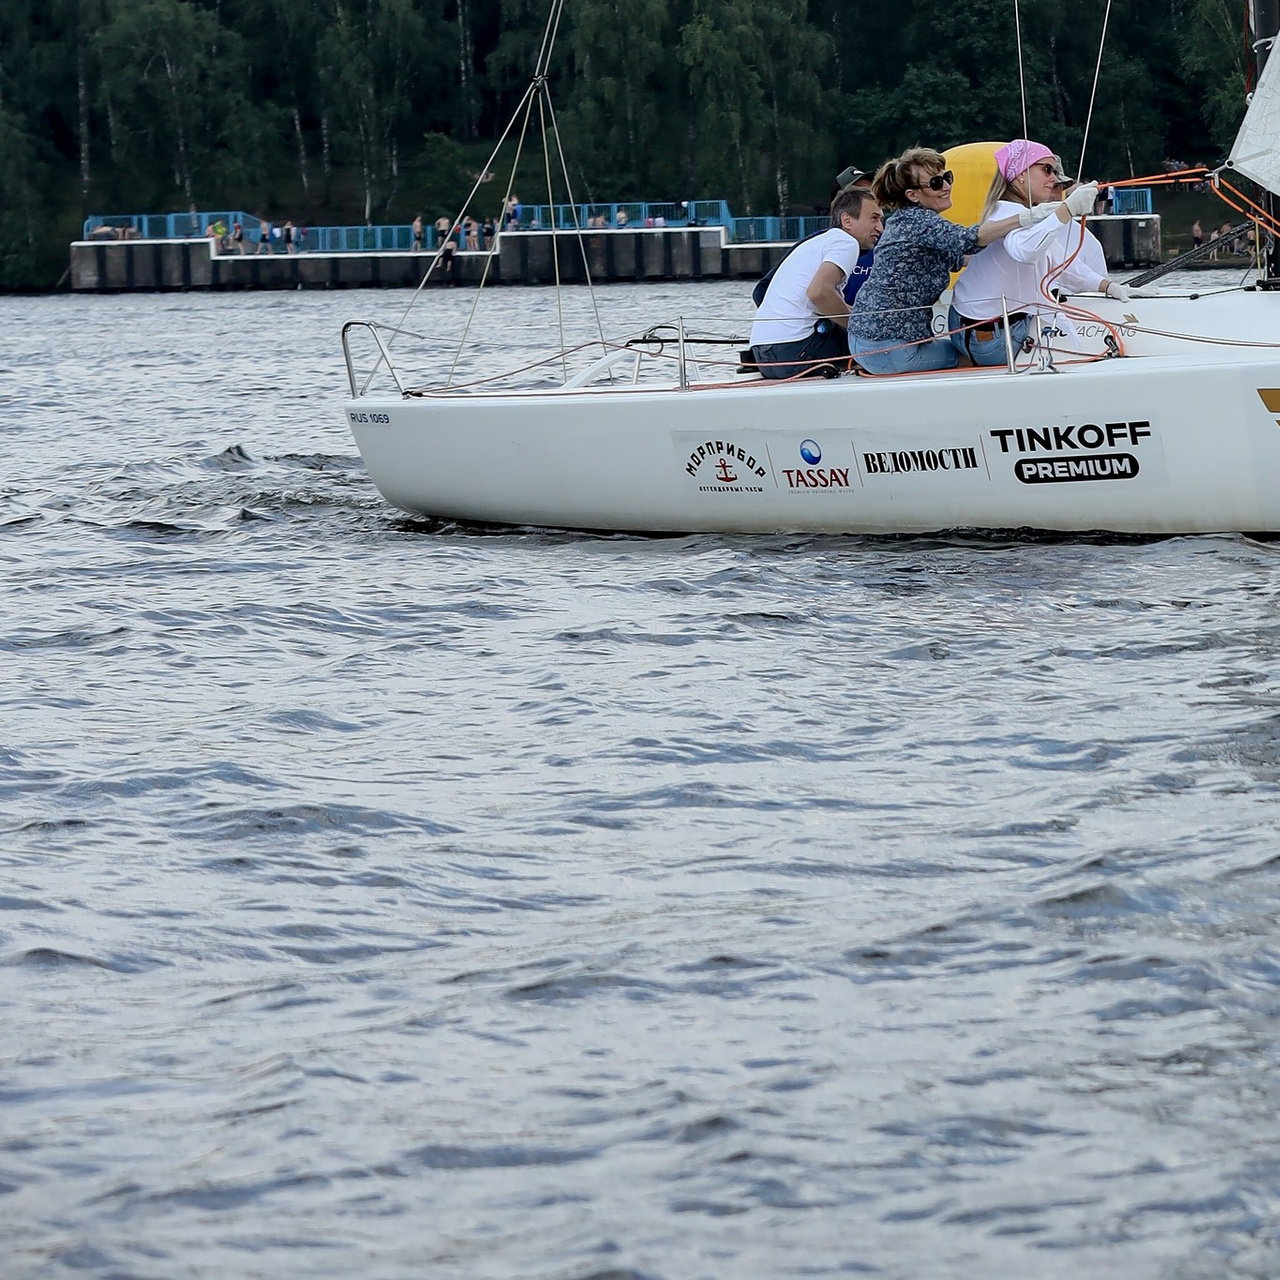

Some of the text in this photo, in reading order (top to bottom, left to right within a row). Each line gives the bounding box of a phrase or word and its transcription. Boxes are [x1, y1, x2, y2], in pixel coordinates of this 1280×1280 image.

[350, 413, 390, 424] RUS 1069
[990, 420, 1151, 454] TINKOFF
[685, 440, 767, 478] МОРПРИБОР
[862, 446, 979, 476] ВЕДОМОСТИ
[1021, 457, 1132, 481] PREMIUM
[781, 468, 850, 489] TASSAY
